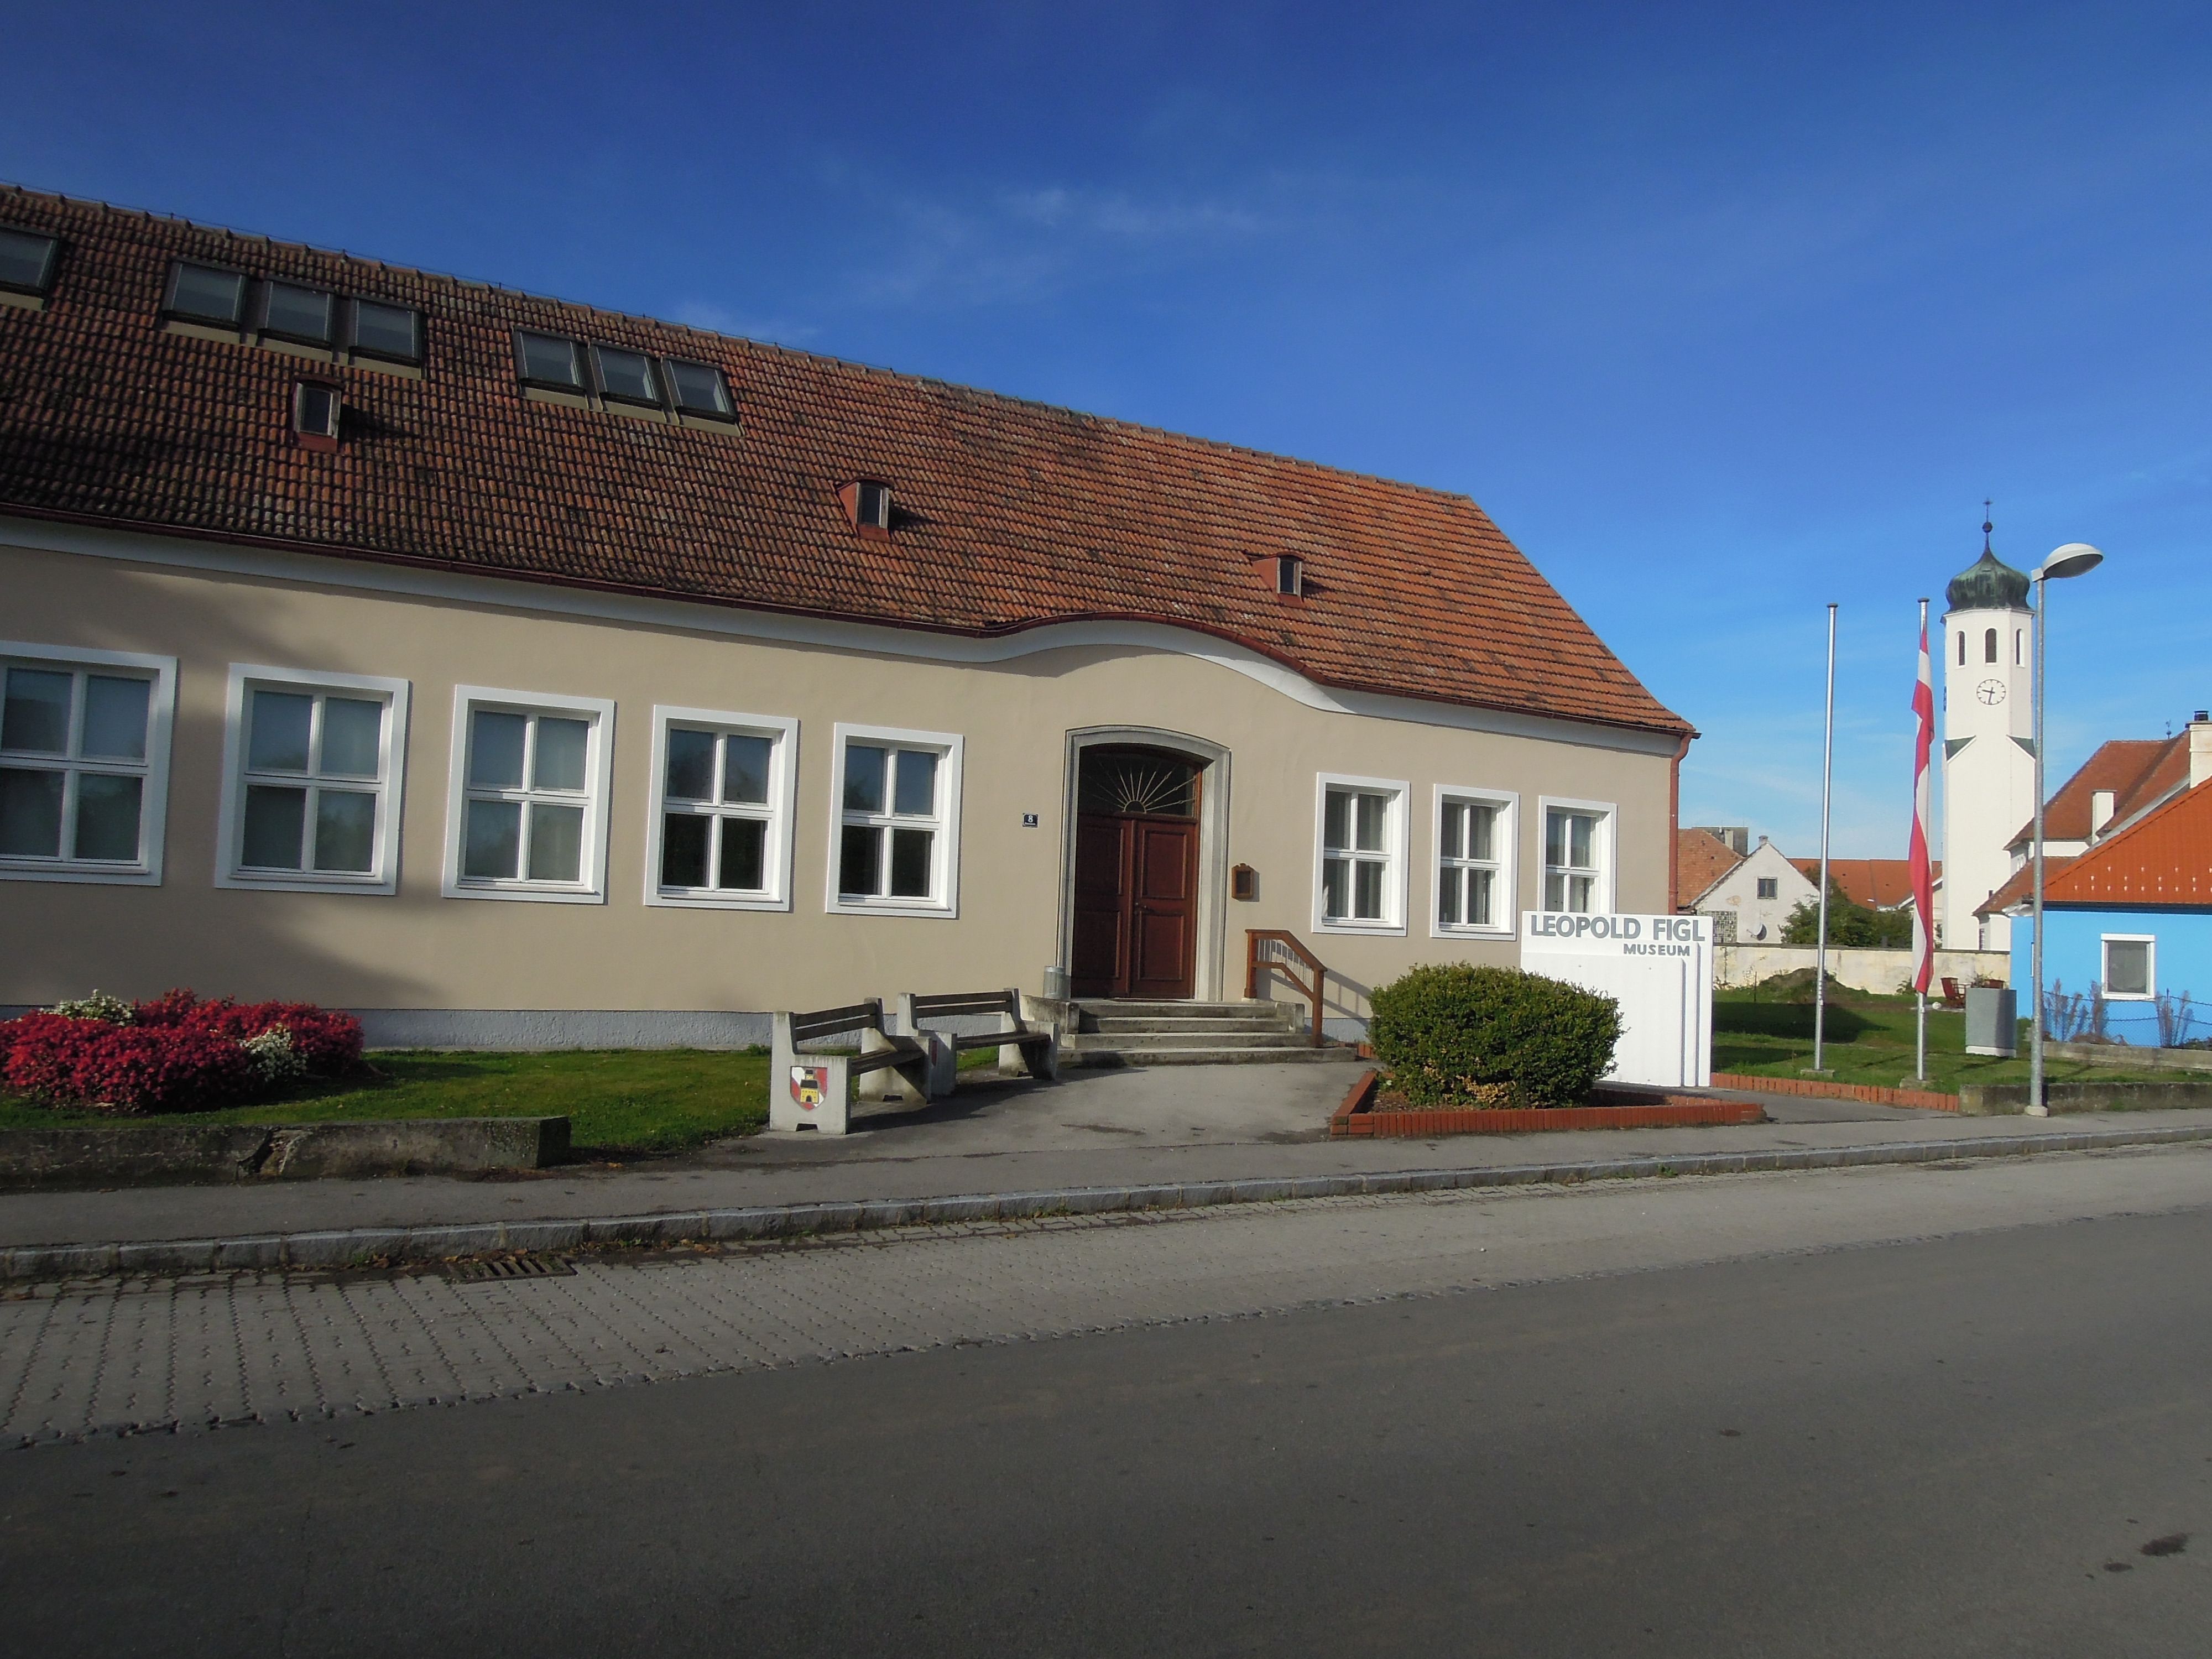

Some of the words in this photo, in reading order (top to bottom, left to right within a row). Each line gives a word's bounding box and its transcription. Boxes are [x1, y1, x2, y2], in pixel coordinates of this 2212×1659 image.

[1531, 915, 1641, 939] LEOPOLD
[1653, 919, 1705, 942] FIGL
[1624, 943, 1690, 956] MUSEUM
